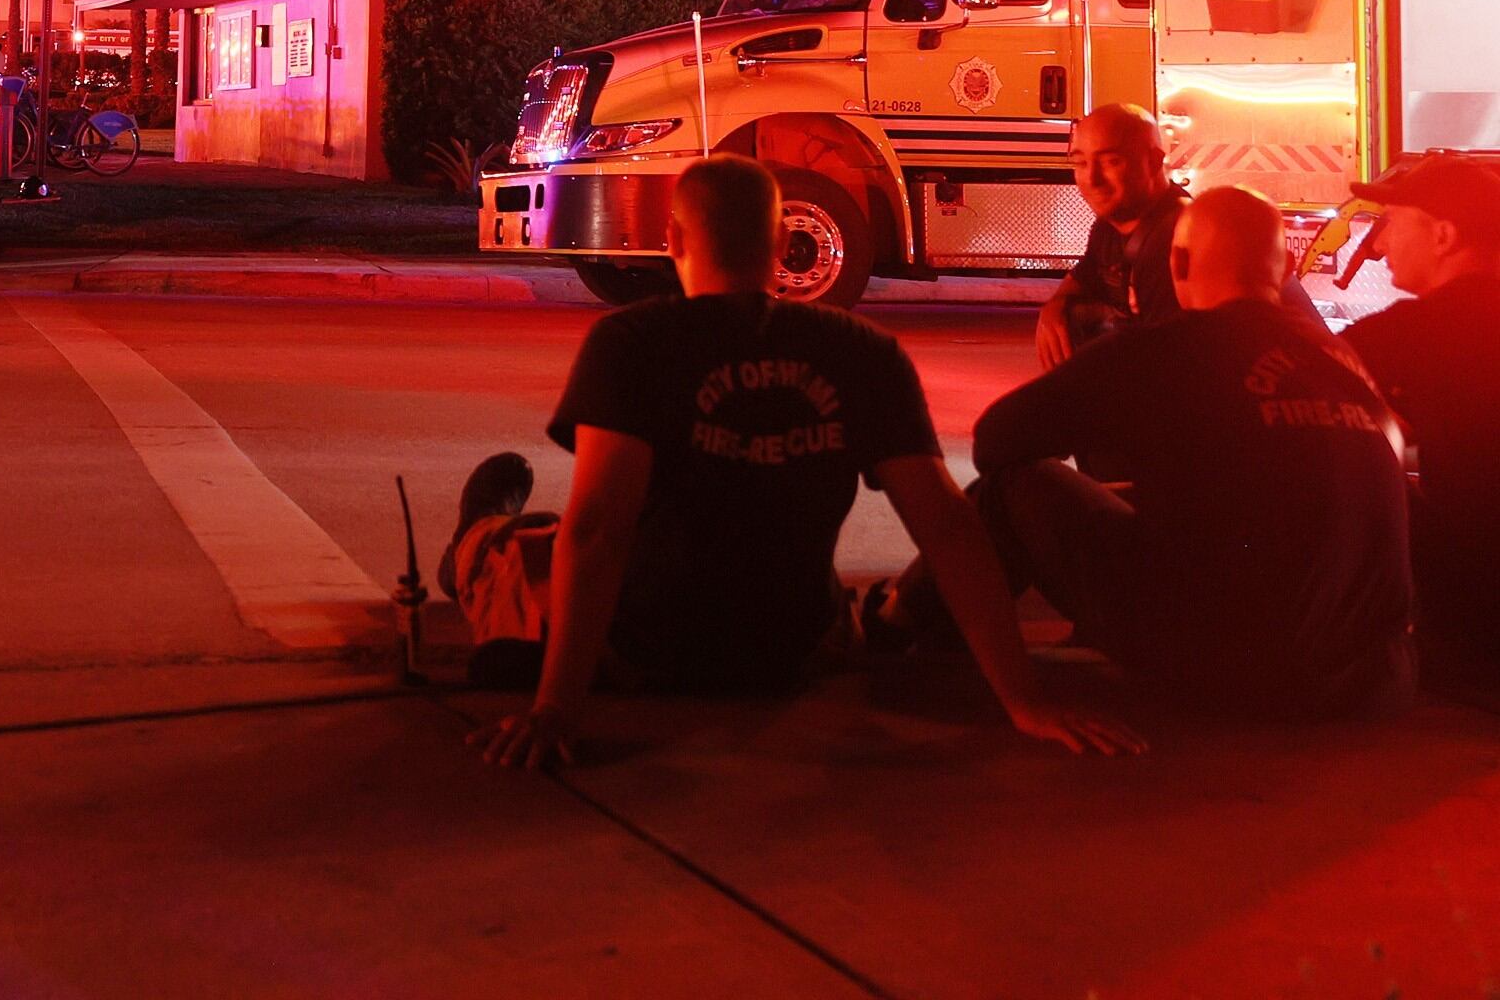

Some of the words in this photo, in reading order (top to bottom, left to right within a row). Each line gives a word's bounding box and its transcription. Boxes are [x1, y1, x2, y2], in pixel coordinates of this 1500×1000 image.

[99, 35, 116, 43] CITY
[872, 100, 921, 112] 21-0628
[738, 360, 775, 391] OF
